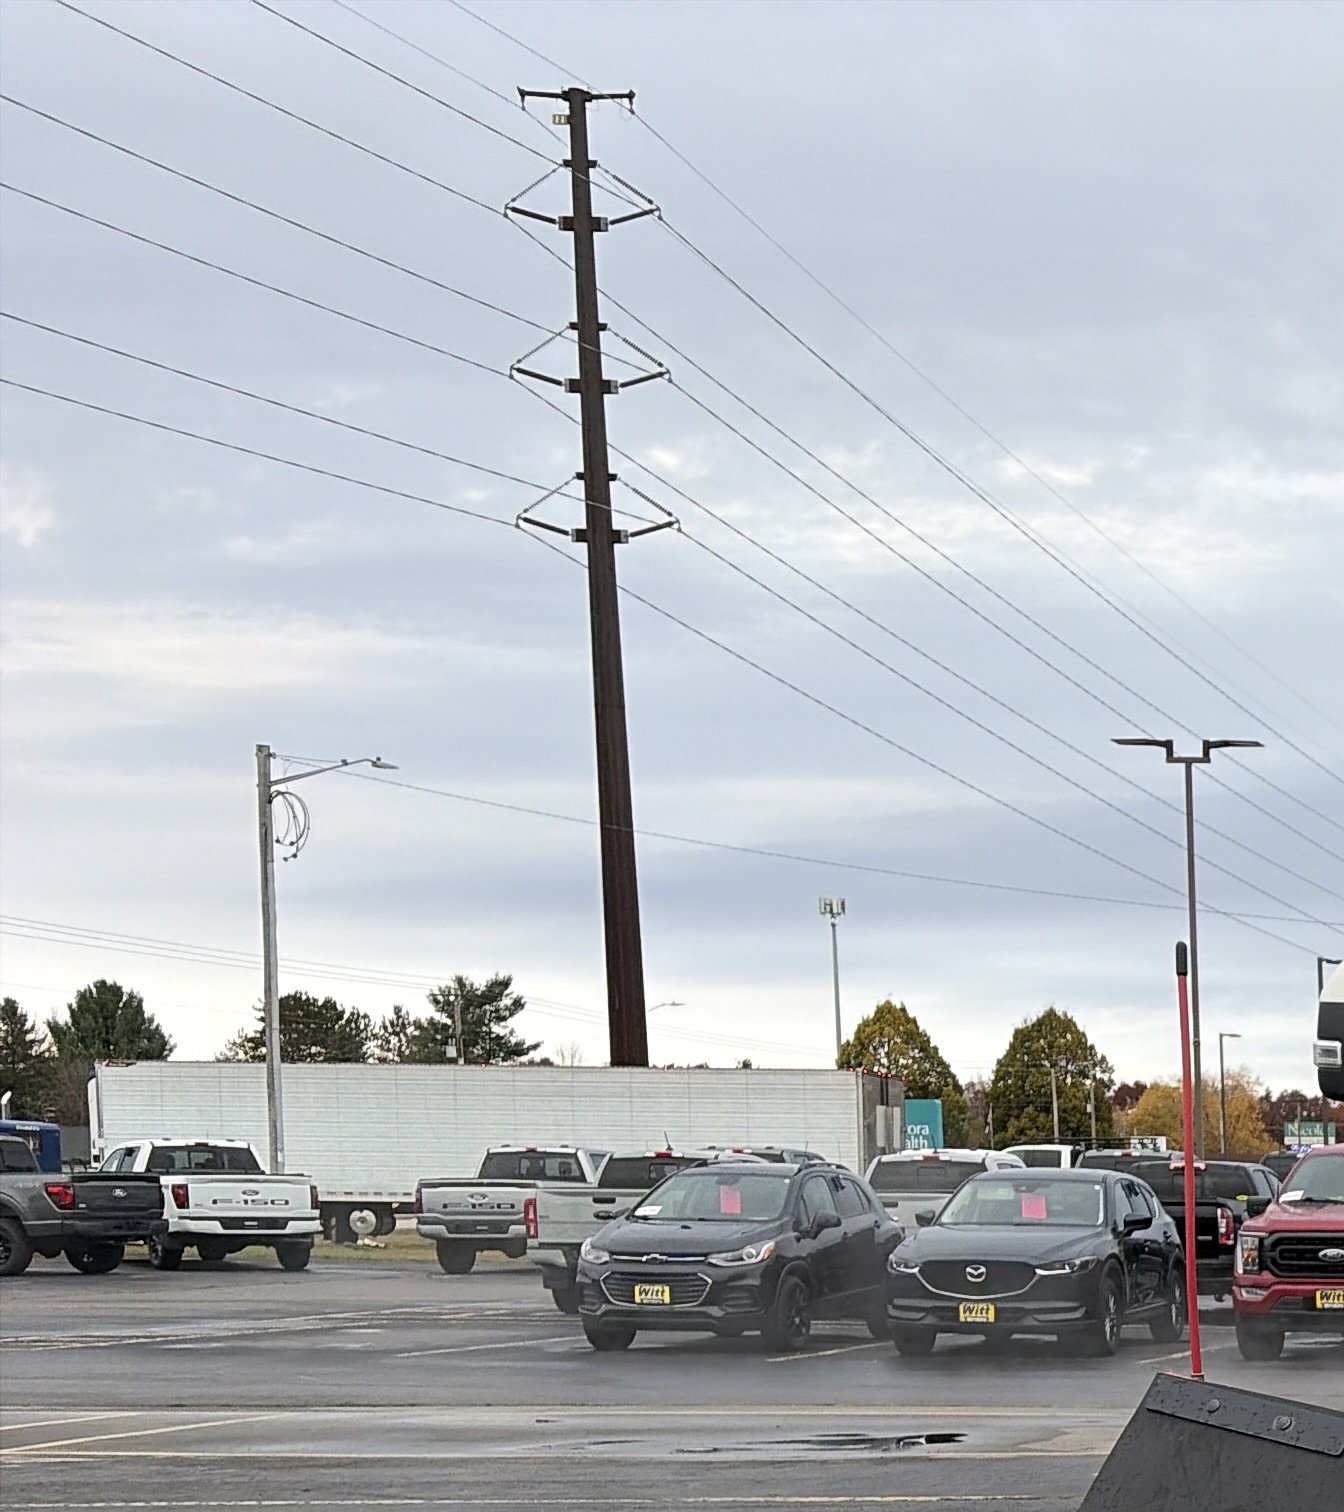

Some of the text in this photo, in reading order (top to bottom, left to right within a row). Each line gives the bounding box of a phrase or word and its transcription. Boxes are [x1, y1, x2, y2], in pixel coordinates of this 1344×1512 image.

[905, 1124, 930, 1135] ora
[905, 1135, 928, 1149] alth
[639, 1286, 665, 1297] Witt
[962, 1303, 990, 1315] Witt
